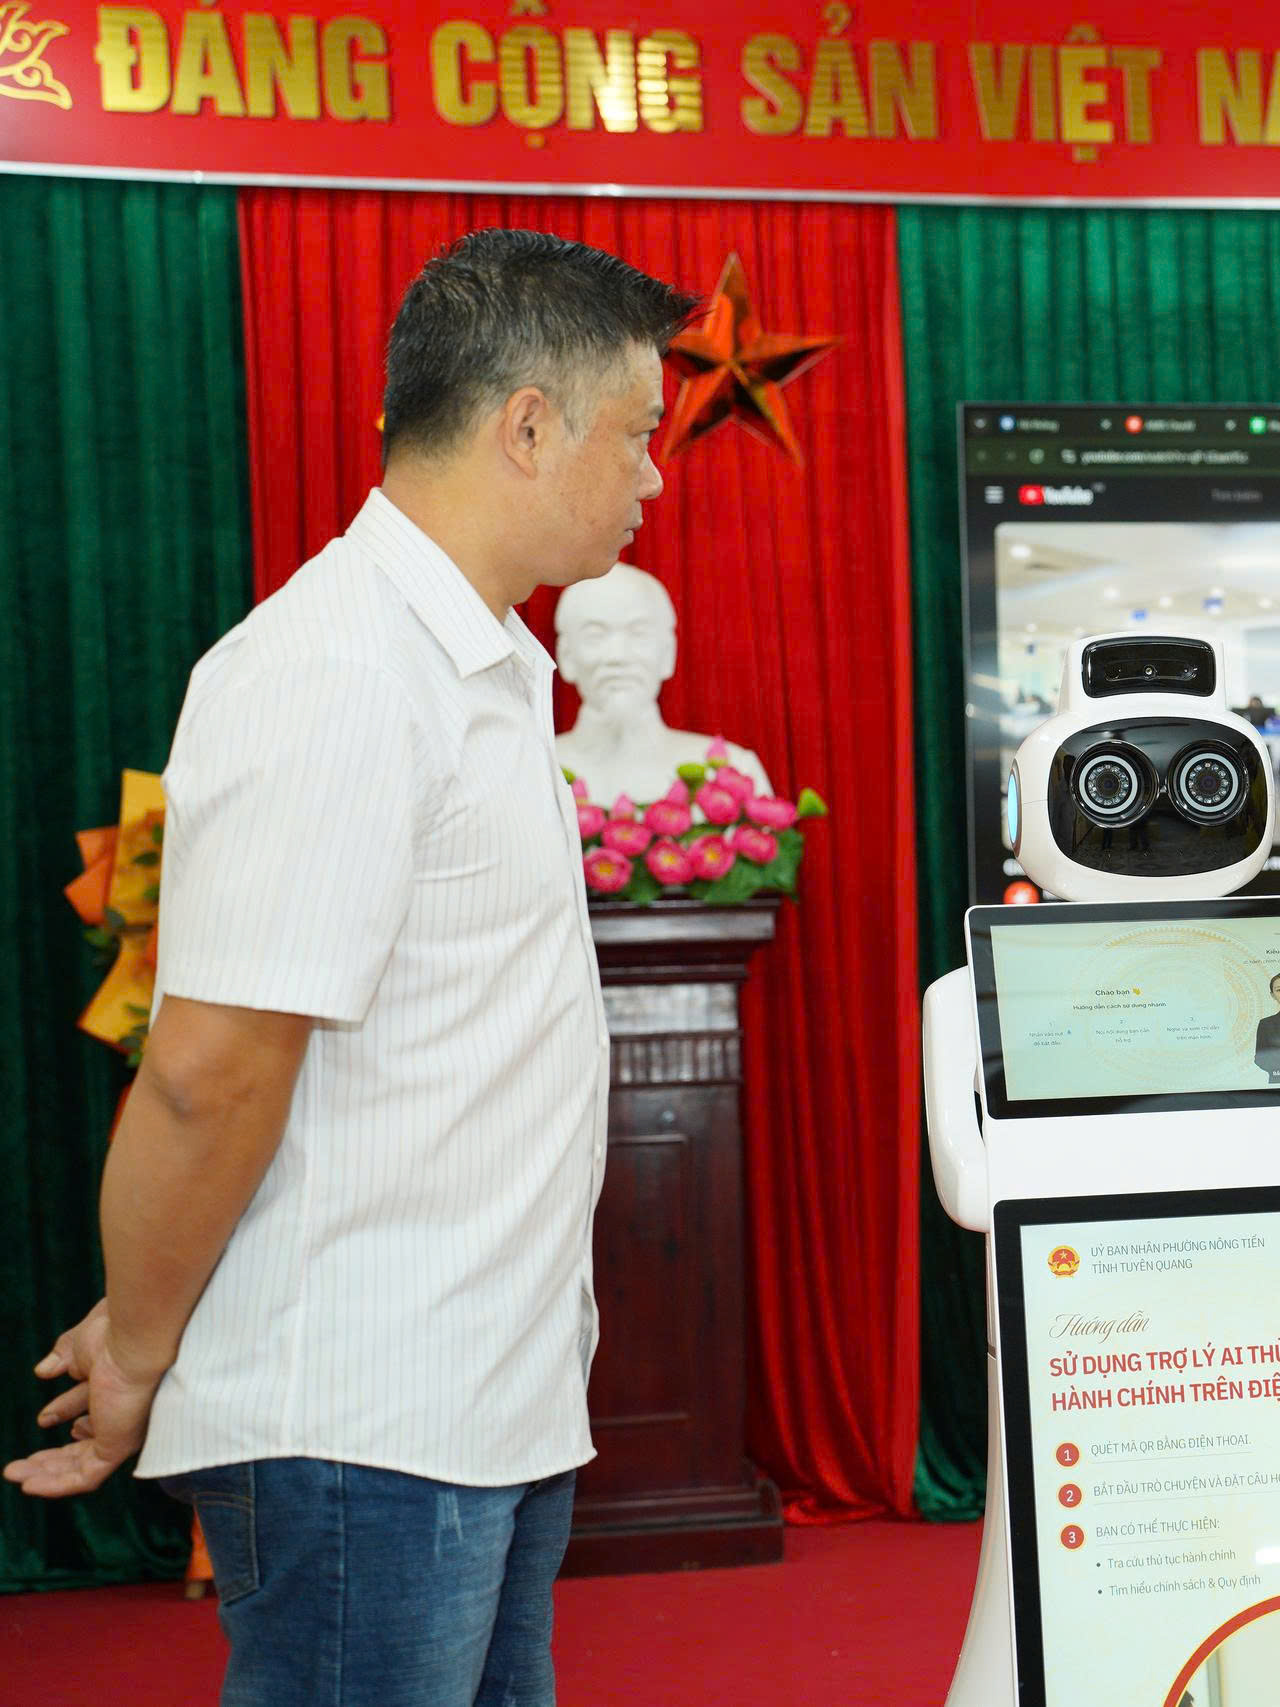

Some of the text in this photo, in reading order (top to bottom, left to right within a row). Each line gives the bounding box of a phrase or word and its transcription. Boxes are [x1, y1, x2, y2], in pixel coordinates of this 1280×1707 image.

[430, 0, 702, 148] CỘNG
[740, 2, 938, 139] SẢN
[969, 23, 1162, 163] VIỆT
[1107, 1245, 1129, 1256] BAN
[1130, 1241, 1161, 1255] NHÂN
[1162, 1236, 1207, 1254] PHƯỜNG
[1208, 1237, 1239, 1250] NÔNG
[1241, 1234, 1265, 1249] TIẾN
[1091, 1258, 1193, 1275] TỈNH TUYÊN QUANG
[1049, 1310, 1150, 1344] Hướng dẫn
[1049, 1350, 1078, 1377] SỬ
[1082, 1353, 1142, 1379] DỤNG
[1146, 1347, 1188, 1374] TRỢ
[1192, 1342, 1216, 1368] LÝ
[1221, 1346, 1244, 1366] AI
[1051, 1384, 1112, 1411] HÀNH
[1117, 1379, 1185, 1407] CHÍNH
[1189, 1375, 1244, 1402] TRÊN
[1063, 1449, 1072, 1462] 1
[1091, 1441, 1120, 1456] QUÉT
[1121, 1439, 1138, 1453] MÃ
[1139, 1440, 1154, 1455] QR
[1188, 1433, 1214, 1451] ĐIỆN
[1066, 1490, 1074, 1503] 2
[1141, 1478, 1162, 1493] TRÒ
[1163, 1475, 1207, 1492] CHUYỆN
[1208, 1473, 1223, 1488] VÀ
[1224, 1473, 1245, 1489] ĐẶT
[1247, 1471, 1269, 1486] CÂU
[1068, 1530, 1076, 1544] 3
[1120, 1521, 1135, 1536] CÓ
[1160, 1519, 1189, 1534] THỰC
[1191, 1516, 1220, 1531] HIỆN:
[1108, 1548, 1236, 1569] Tra cứu thủ tục hành chính
[1109, 1574, 1262, 1597] Tìm hiểu chính sách & Quy định
